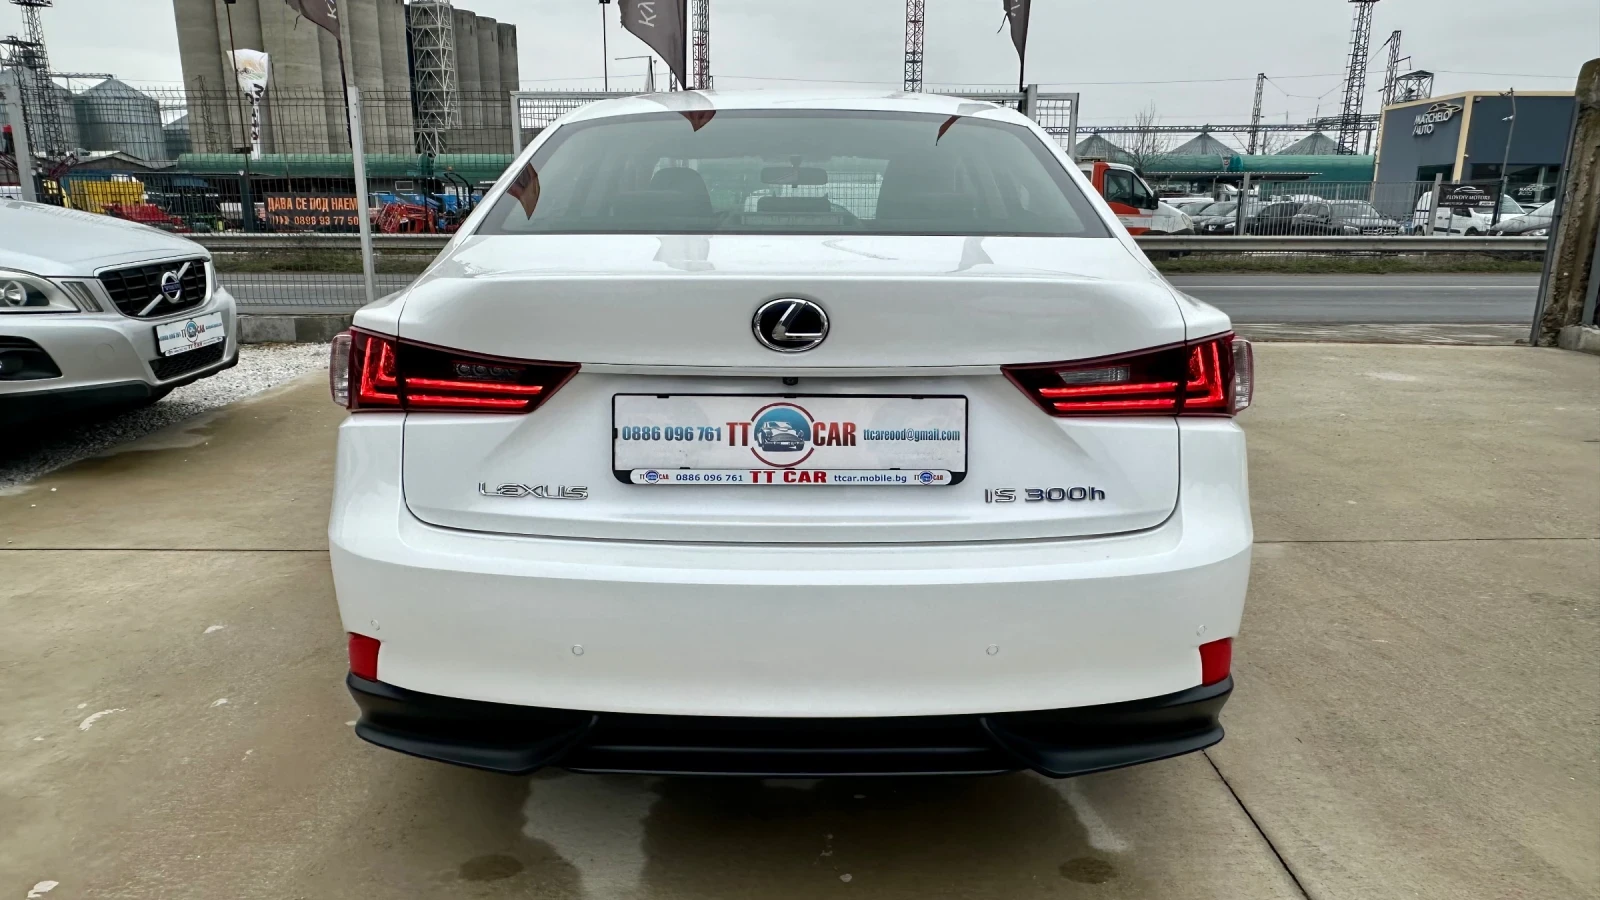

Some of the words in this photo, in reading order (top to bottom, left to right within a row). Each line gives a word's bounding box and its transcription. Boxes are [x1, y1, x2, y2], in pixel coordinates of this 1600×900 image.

[1414, 110, 1452, 126] MARCHELO
[1412, 123, 1434, 137] AUTO
[267, 197, 293, 213] ДАВА
[295, 198, 308, 211] СЕ
[309, 197, 330, 213] ПОД
[331, 197, 359, 212] НАЕМ
[294, 215, 317, 226] 0898
[319, 215, 331, 226] 93
[333, 215, 345, 226] 77
[347, 215, 359, 226] 50
[621, 425, 662, 442] 0886
[664, 425, 694, 442] 096
[697, 426, 722, 442] 761
[726, 421, 751, 447] TT
[812, 421, 857, 447] CAR
[863, 427, 961, 444] ttcareood@gmail.com
[675, 474, 701, 482] 0886
[703, 474, 722, 482] 096
[725, 474, 743, 482] 761
[749, 470, 776, 484] TT
[783, 470, 827, 484] CAR
[834, 474, 907, 484] ttcar.mobile.bg
[478, 482, 589, 501] LEXUS
[984, 487, 1017, 504] IS
[1024, 486, 1106, 503] 300h
